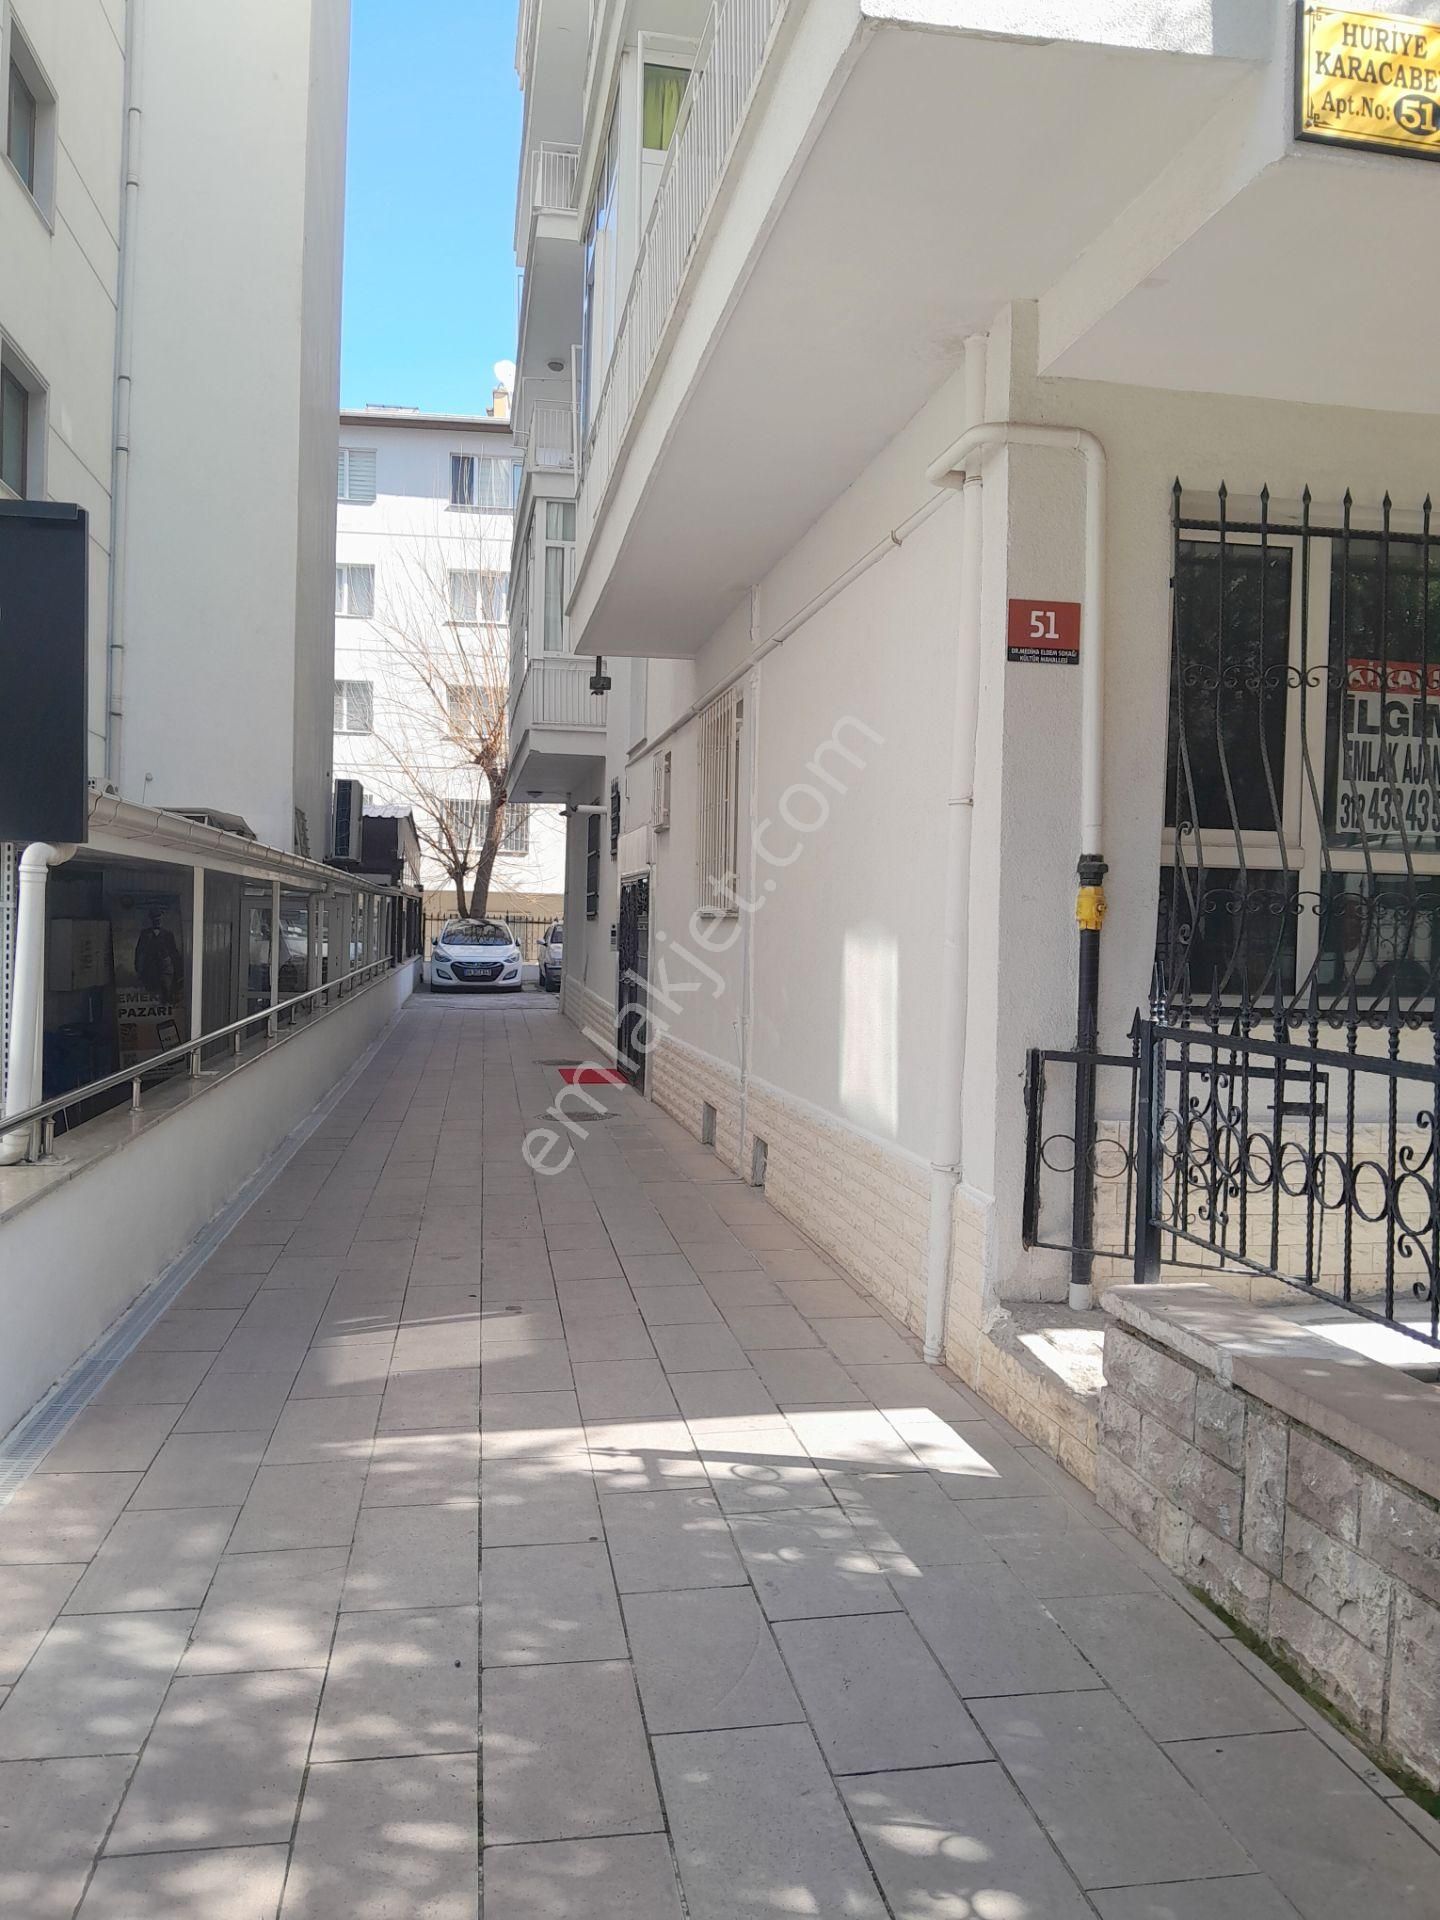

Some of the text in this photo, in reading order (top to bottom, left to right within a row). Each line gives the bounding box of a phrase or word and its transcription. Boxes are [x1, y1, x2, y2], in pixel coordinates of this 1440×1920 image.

[1341, 22, 1428, 59] HURİYE
[1315, 50, 1440, 94] KARACABE
[1321, 90, 1437, 131] Apt.No: 51
[1030, 610, 1059, 639] 51
[1343, 740, 1398, 784] EMLAK
[1340, 792, 1366, 829] 312
[118, 1006, 172, 1019] PAZARI
